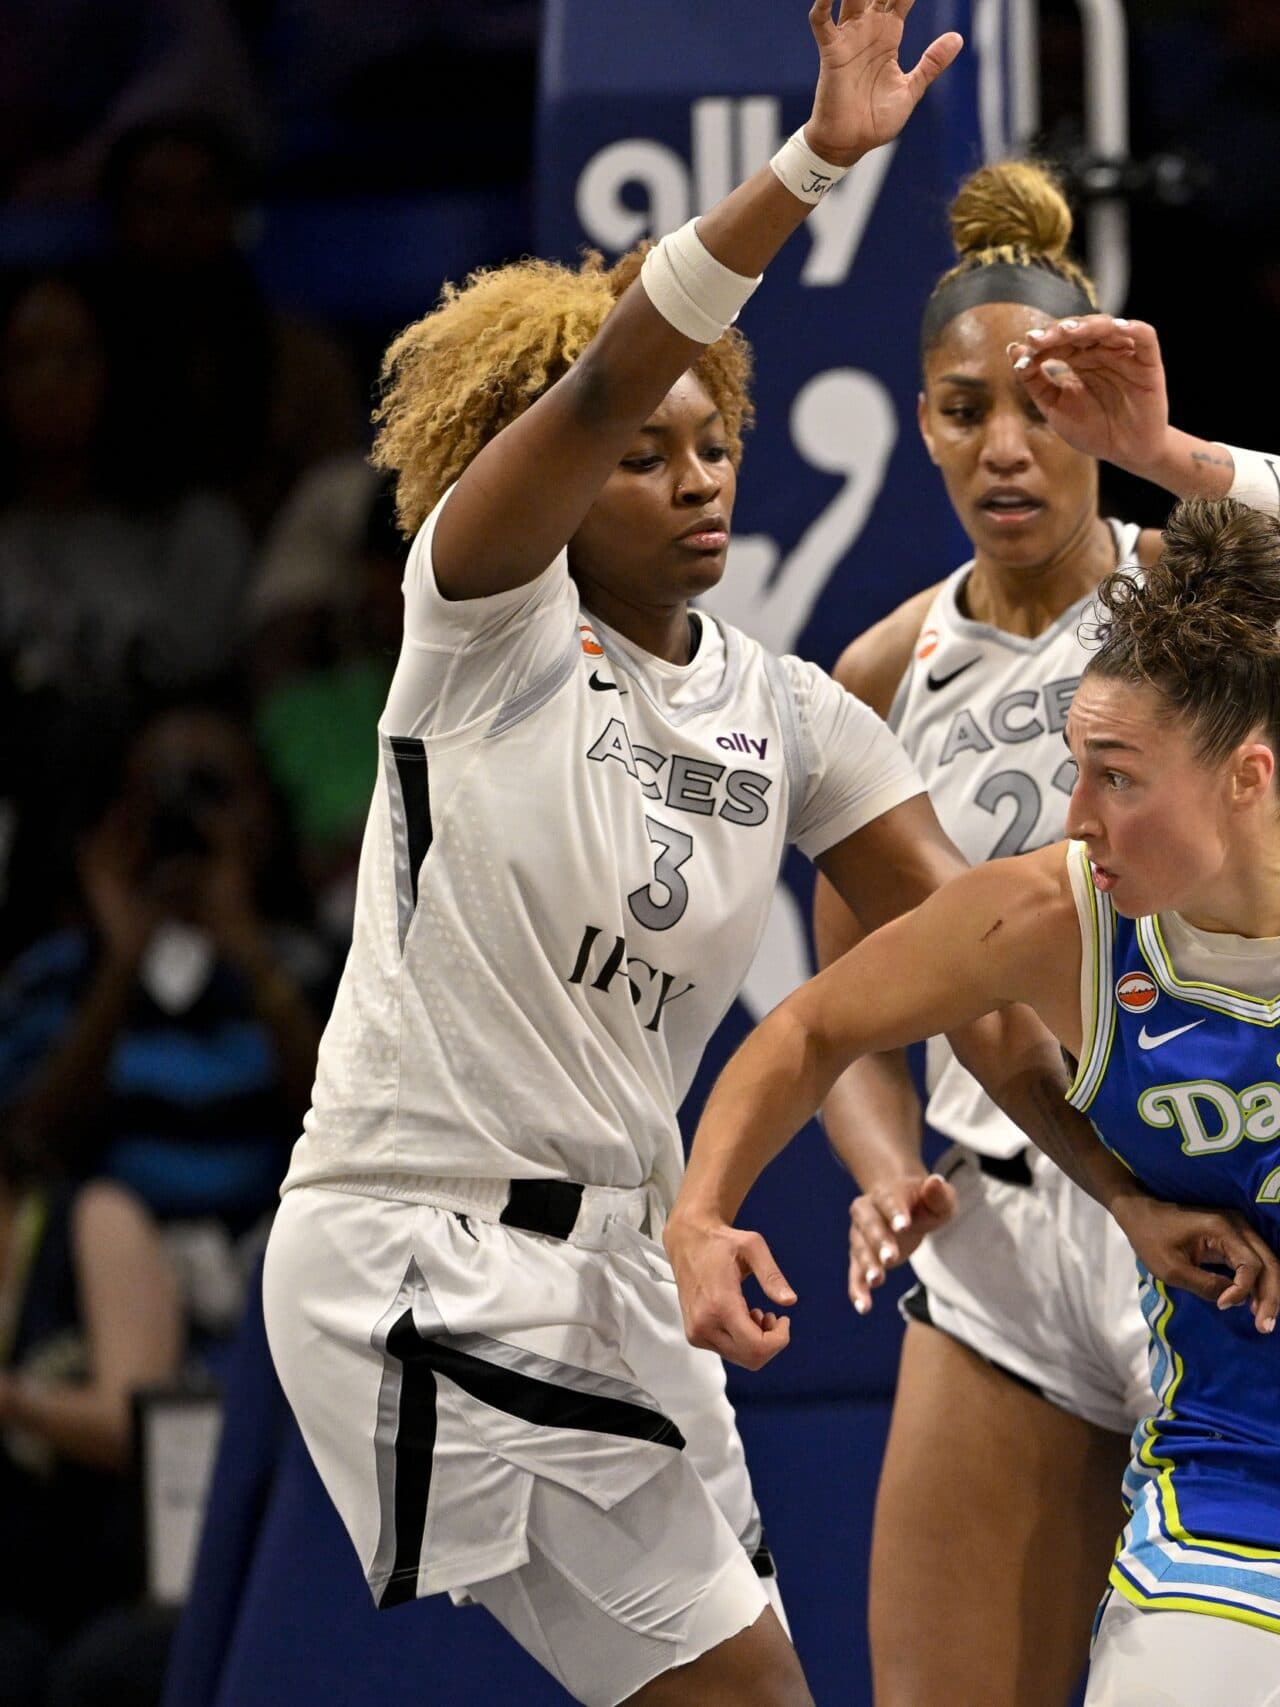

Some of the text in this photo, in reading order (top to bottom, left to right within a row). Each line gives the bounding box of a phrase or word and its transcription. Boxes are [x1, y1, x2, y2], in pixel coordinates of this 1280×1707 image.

[716, 733, 768, 760] ally
[938, 676, 1083, 767] ACE
[587, 718, 773, 826] ACES
[628, 815, 694, 931] 3
